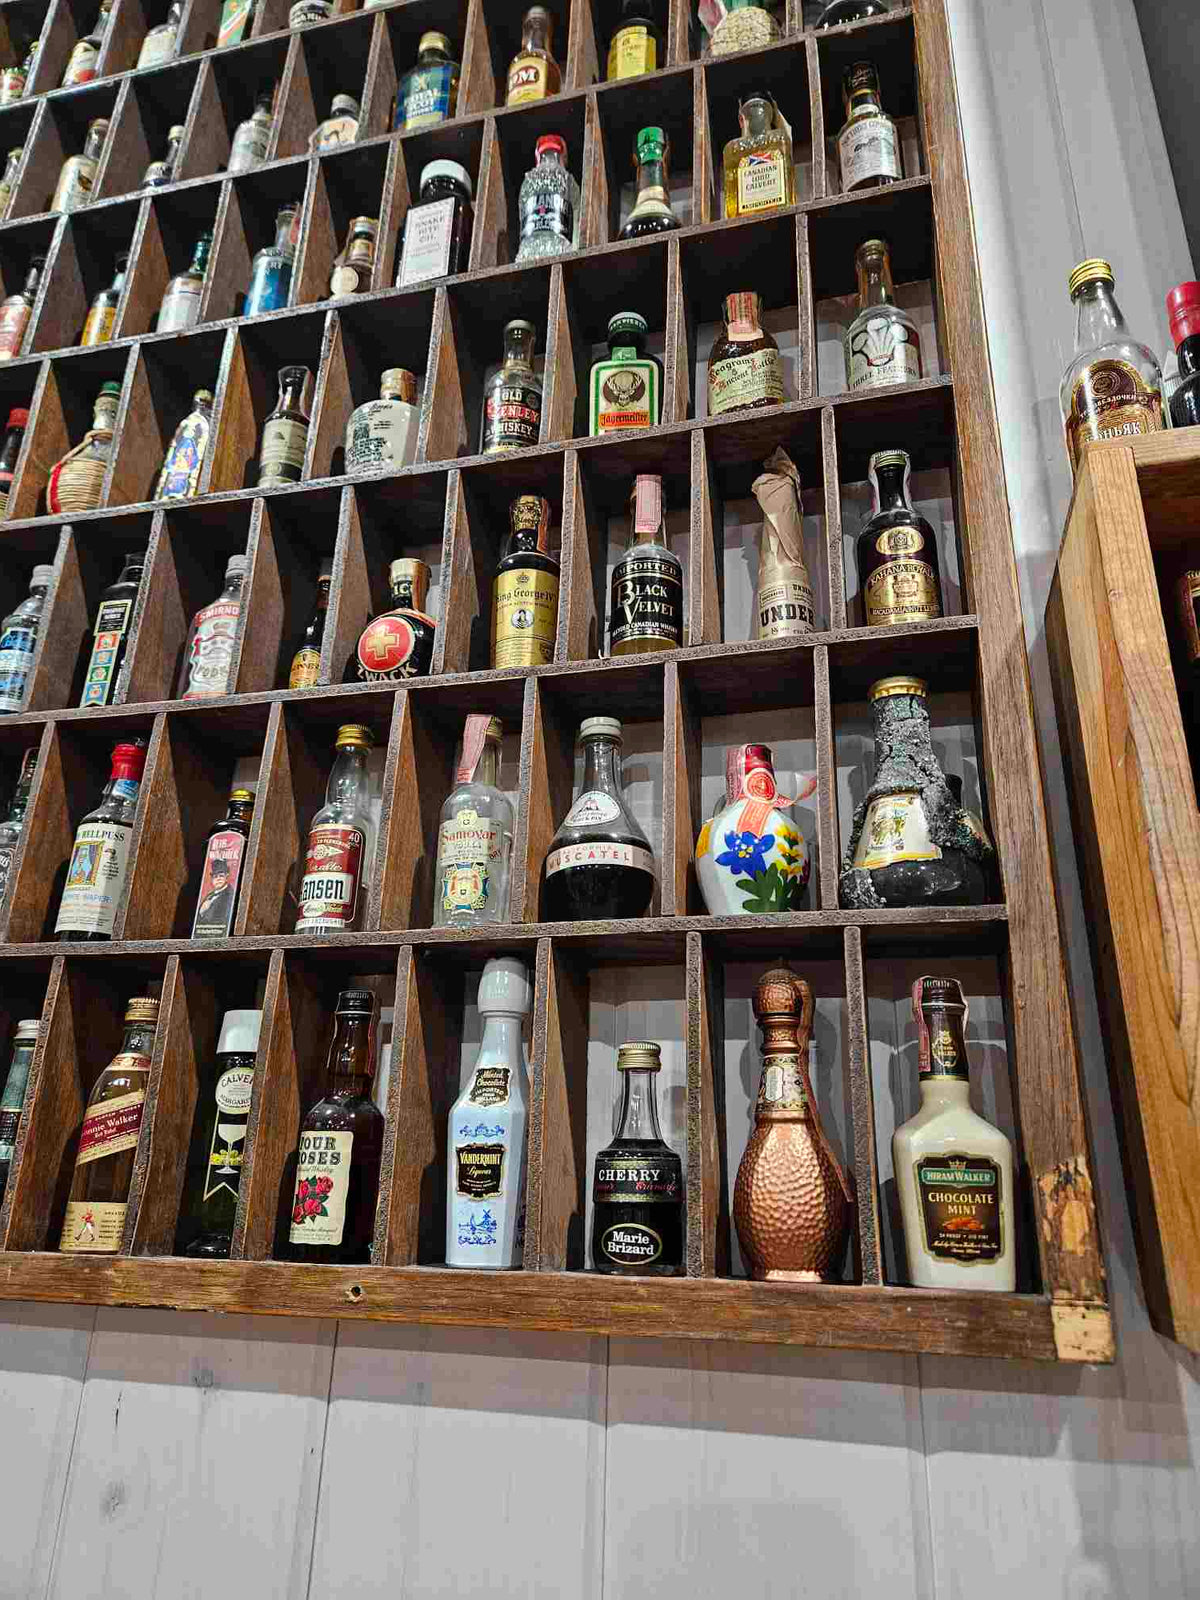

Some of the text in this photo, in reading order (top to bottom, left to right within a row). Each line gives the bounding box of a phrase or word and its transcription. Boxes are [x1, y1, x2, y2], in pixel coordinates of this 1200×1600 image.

[502, 387, 523, 401] OLD
[600, 412, 648, 426] Jägermeister
[615, 561, 677, 577] IMPORTED
[617, 580, 668, 607] BLACK
[201, 605, 240, 621] SMIRNO
[623, 596, 675, 625] VELVET
[356, 664, 419, 682] ZWACK
[348, 832, 360, 843] 40
[444, 831, 497, 842] Samovar
[302, 878, 344, 901] ansen
[106, 1113, 139, 1128] Walker
[299, 1151, 340, 1165] OSES
[459, 1151, 501, 1166] VANDERMINT
[598, 1169, 660, 1182] CHERRY
[926, 1171, 991, 1182] HIRAM WALKER
[928, 1192, 994, 1204] CHOCOLATE
[947, 1204, 977, 1216] MINT
[612, 1230, 650, 1245] Marie
[607, 1241, 655, 1256] Brizard
